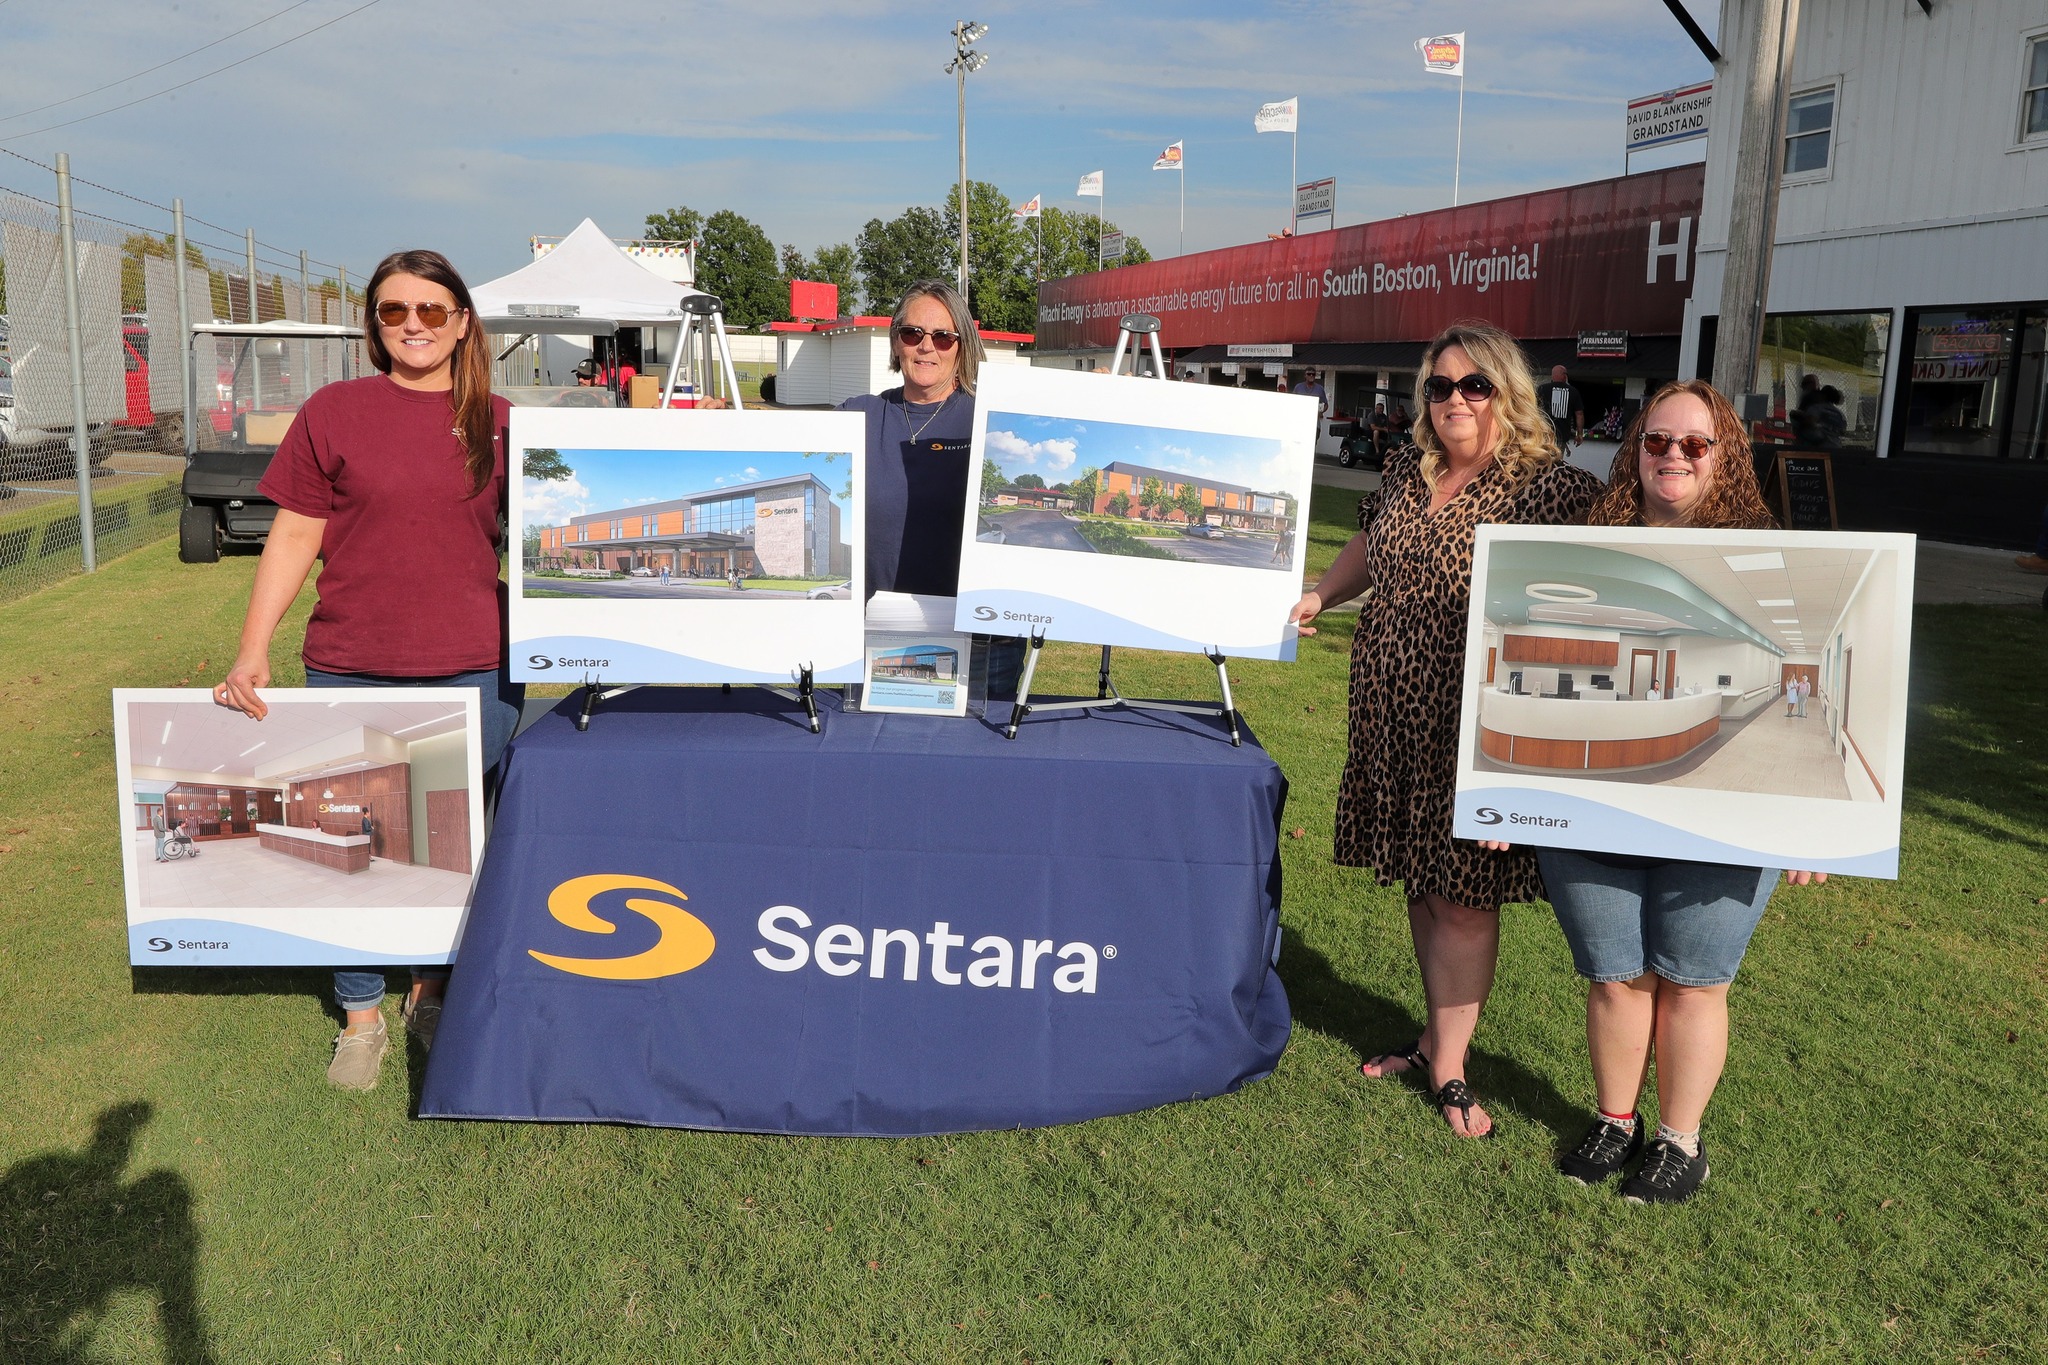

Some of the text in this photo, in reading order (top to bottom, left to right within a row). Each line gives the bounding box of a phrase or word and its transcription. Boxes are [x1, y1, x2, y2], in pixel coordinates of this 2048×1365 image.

[1628, 111, 1651, 125] DAVID
[1653, 96, 1712, 119] BLANKENSHIP
[1633, 114, 1704, 141] GRANDSTAND
[1300, 188, 1330, 202] ELLIOTT SADLER
[1299, 199, 1330, 212] GRANDSTAND
[1039, 302, 1061, 323] Hitachi
[1061, 300, 1085, 325] Energy
[1085, 299, 1091, 319] is
[1130, 299, 1136, 315] a
[1137, 288, 1188, 314] sustainable
[1190, 286, 1227, 314] energy
[1228, 280, 1263, 306] future
[1265, 276, 1284, 303] for
[1286, 272, 1302, 301] all
[1305, 271, 1318, 299] in
[1322, 265, 1368, 298] South
[1372, 261, 1441, 295] Boston,
[1448, 243, 1539, 293] Virginia!
[1582, 337, 1623, 345] PERKINS RACING
[1937, 337, 1997, 349] RACING
[773, 507, 798, 516] Sentara
[328, 803, 360, 813] Sentara
